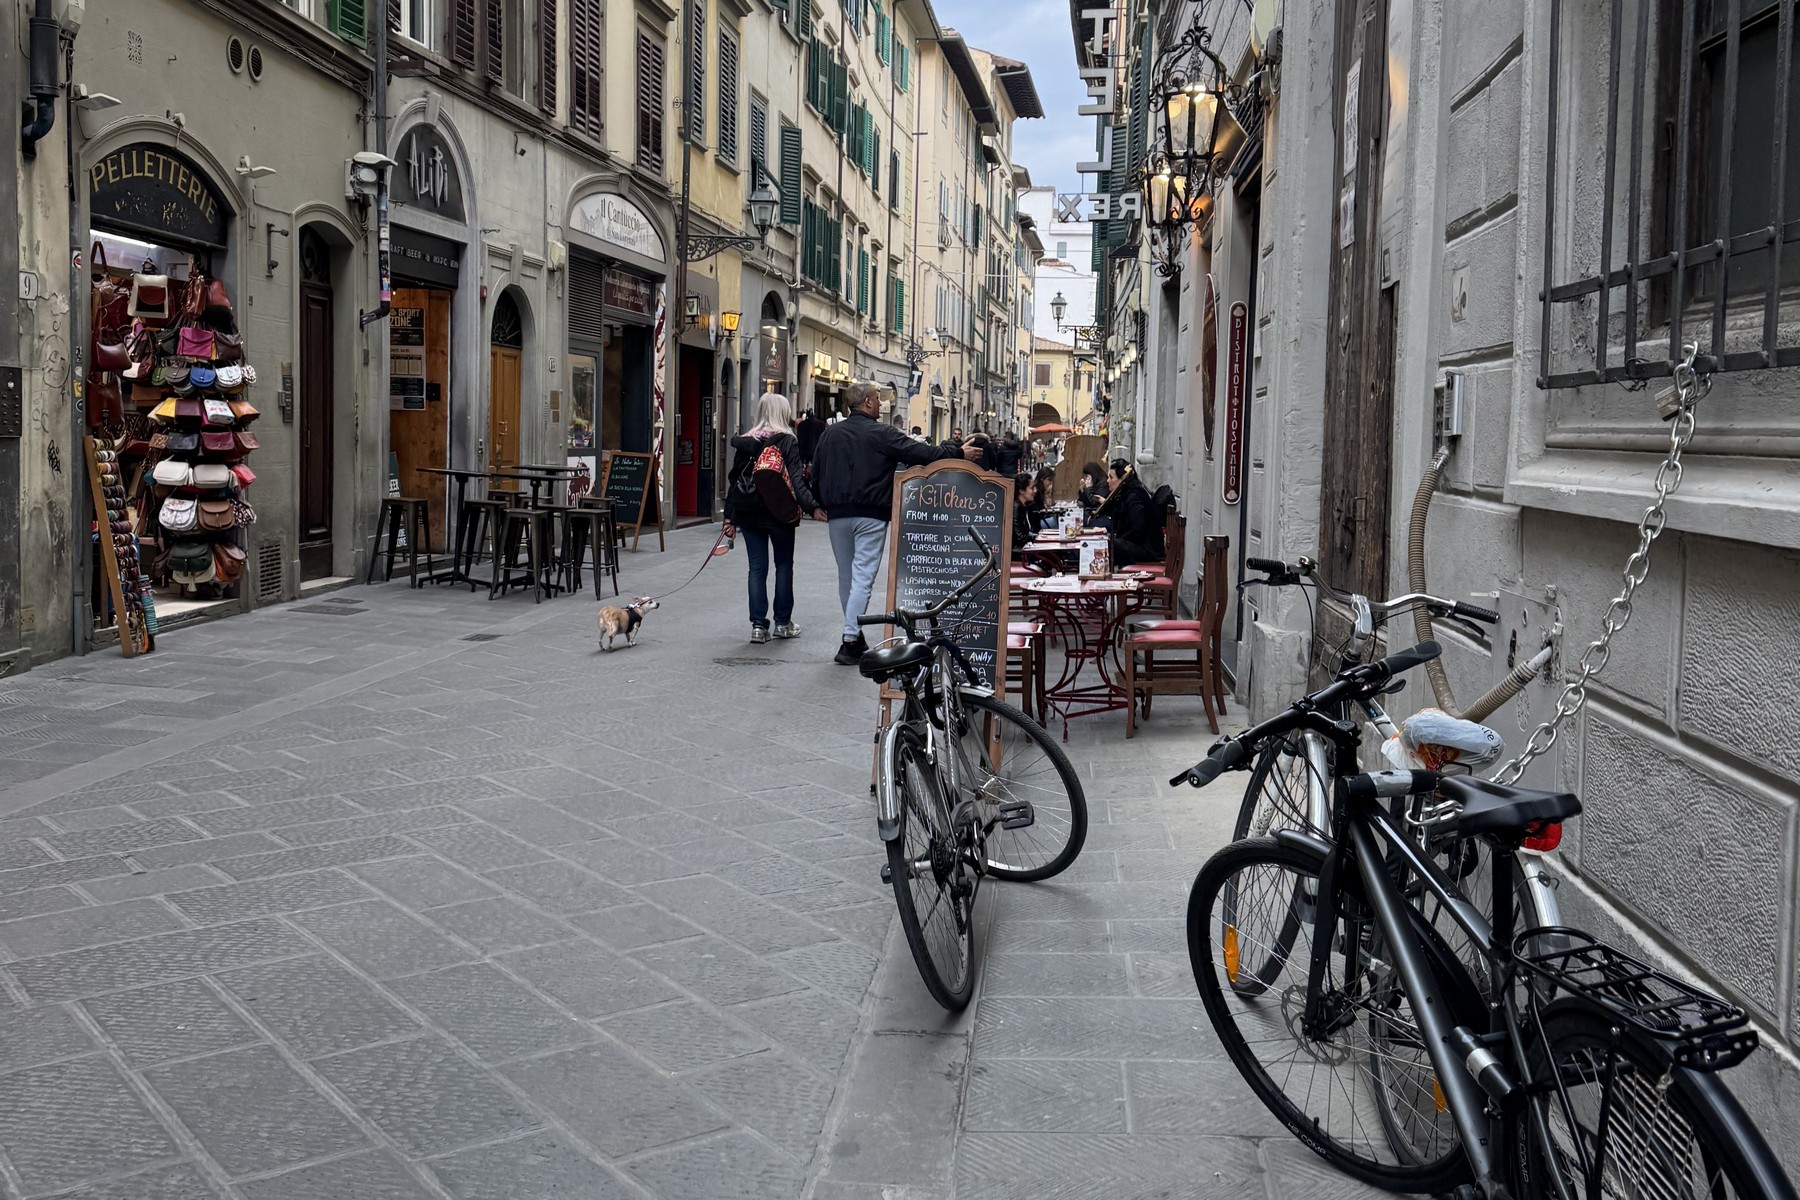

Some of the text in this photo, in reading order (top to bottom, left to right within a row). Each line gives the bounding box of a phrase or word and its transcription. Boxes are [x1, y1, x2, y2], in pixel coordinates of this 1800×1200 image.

[91, 150, 218, 224] PELLETTERIE
[607, 200, 641, 232] Cantuccio
[390, 243, 404, 255] RAFT
[406, 247, 422, 259] BEER
[23, 275, 32, 296] 9
[398, 308, 420, 317] SPORT
[390, 316, 412, 327] ZONE
[1229, 408, 1239, 487] TOSCANO
[906, 510, 928, 521] FROM
[961, 514, 971, 523] TO
[906, 532, 939, 543] TARTARE
[906, 554, 942, 565] CARPACCIO
[952, 557, 974, 566] BLACK
[911, 564, 959, 574] PISTACCHIOSA
[905, 576, 937, 586] LASAGNA
[904, 588, 914, 596] LA
[914, 588, 942, 596] CAPRESE
[986, 611, 997, 620] 10
[969, 651, 993, 664] AWAY
